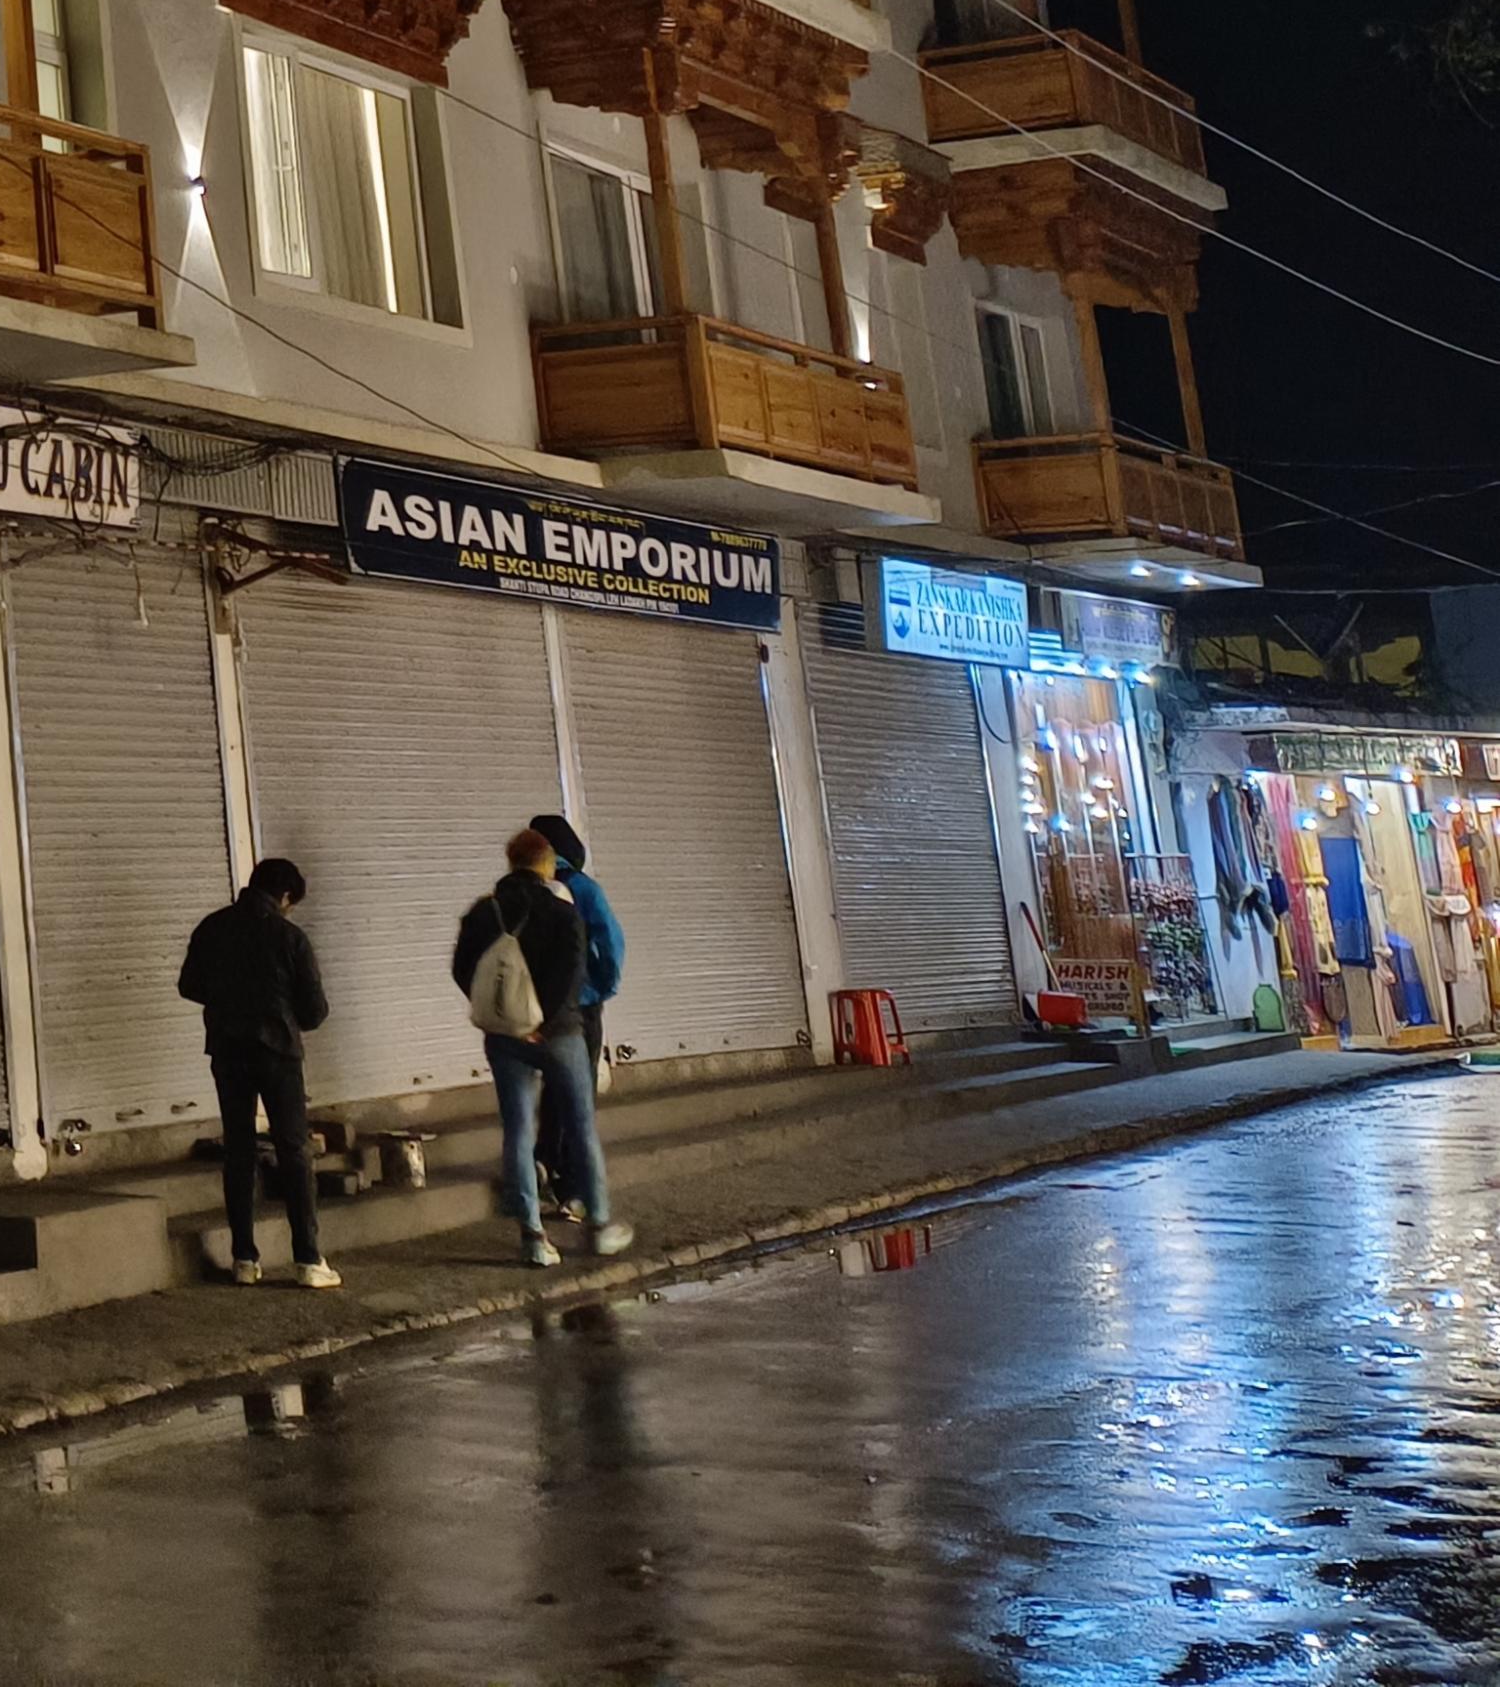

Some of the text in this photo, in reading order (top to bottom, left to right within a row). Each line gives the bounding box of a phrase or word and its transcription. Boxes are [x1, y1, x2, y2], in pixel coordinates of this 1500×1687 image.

[20, 438, 130, 509] CABIN
[365, 489, 527, 555] ASIAN
[542, 519, 772, 594] EMPORIUM
[459, 550, 710, 605] AN EXCLUSIVE COLLECTION
[918, 608, 1024, 648] EXPEDITION
[1057, 964, 1129, 980] HARISH
